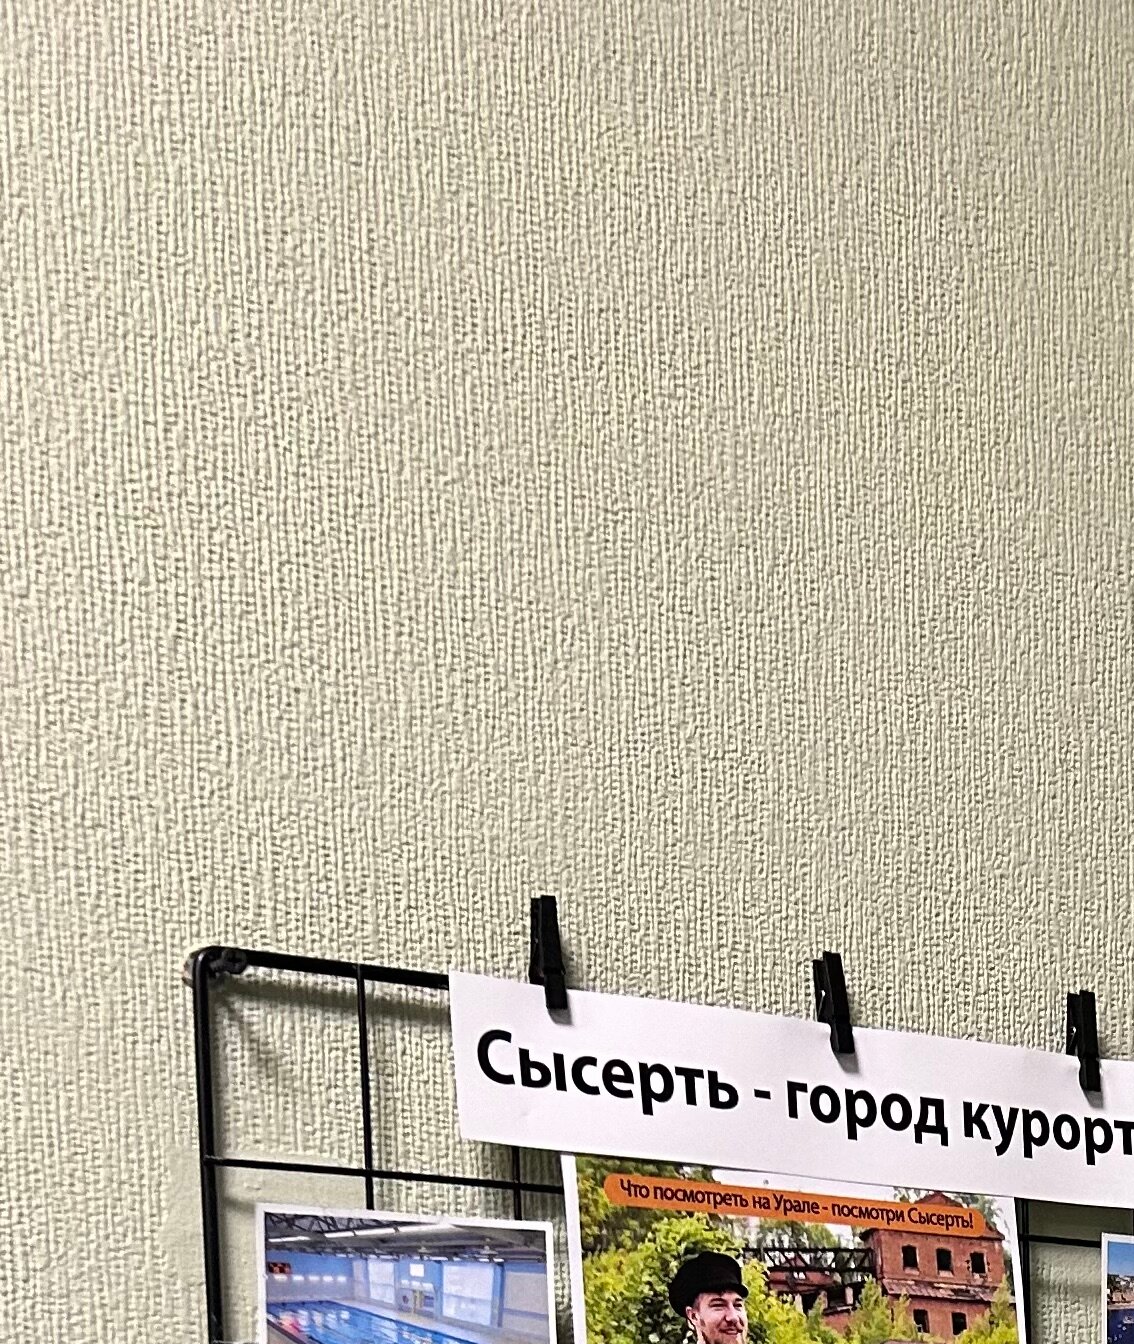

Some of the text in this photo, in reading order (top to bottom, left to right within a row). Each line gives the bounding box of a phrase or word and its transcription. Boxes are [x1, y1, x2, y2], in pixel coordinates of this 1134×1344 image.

[477, 1028, 738, 1116] Сысерть
[786, 1076, 948, 1145] город
[620, 1179, 973, 1228] Что посмотреть на Урале посмотри Сысерть!
